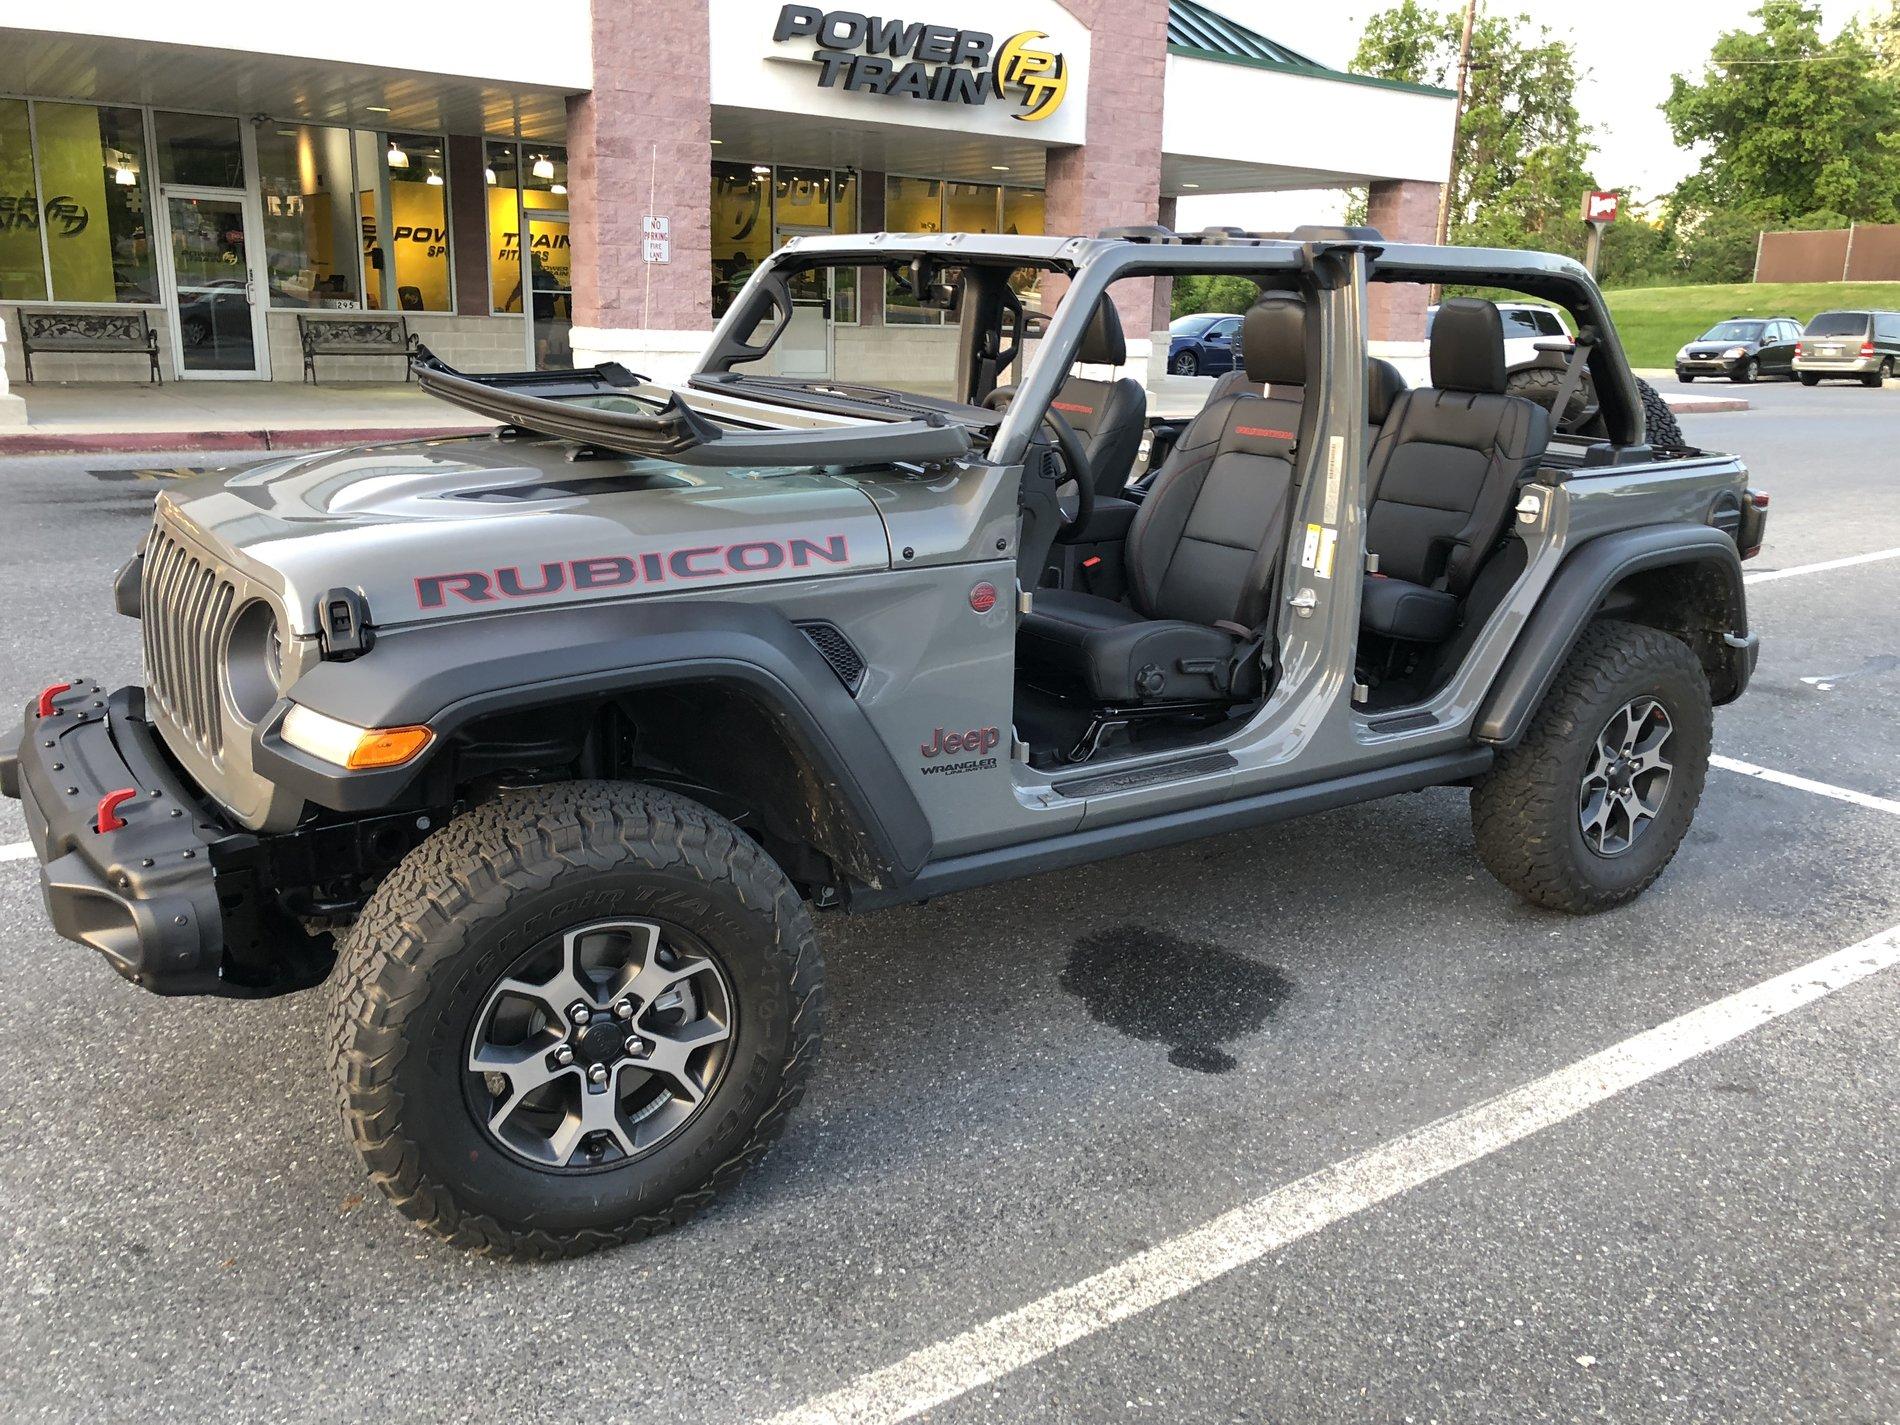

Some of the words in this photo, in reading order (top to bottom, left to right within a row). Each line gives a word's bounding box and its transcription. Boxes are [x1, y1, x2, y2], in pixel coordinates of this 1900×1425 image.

[773, 4, 993, 67] POWER
[812, 50, 993, 105] TRAIN
[650, 220, 661, 230] NO
[644, 231, 669, 242] PARKING
[650, 242, 662, 250] FIRE
[650, 251, 663, 260] LANE
[413, 535, 849, 610] RUBICON
[921, 726, 1000, 758] Jeep
[920, 757, 997, 775] WRANGLER
